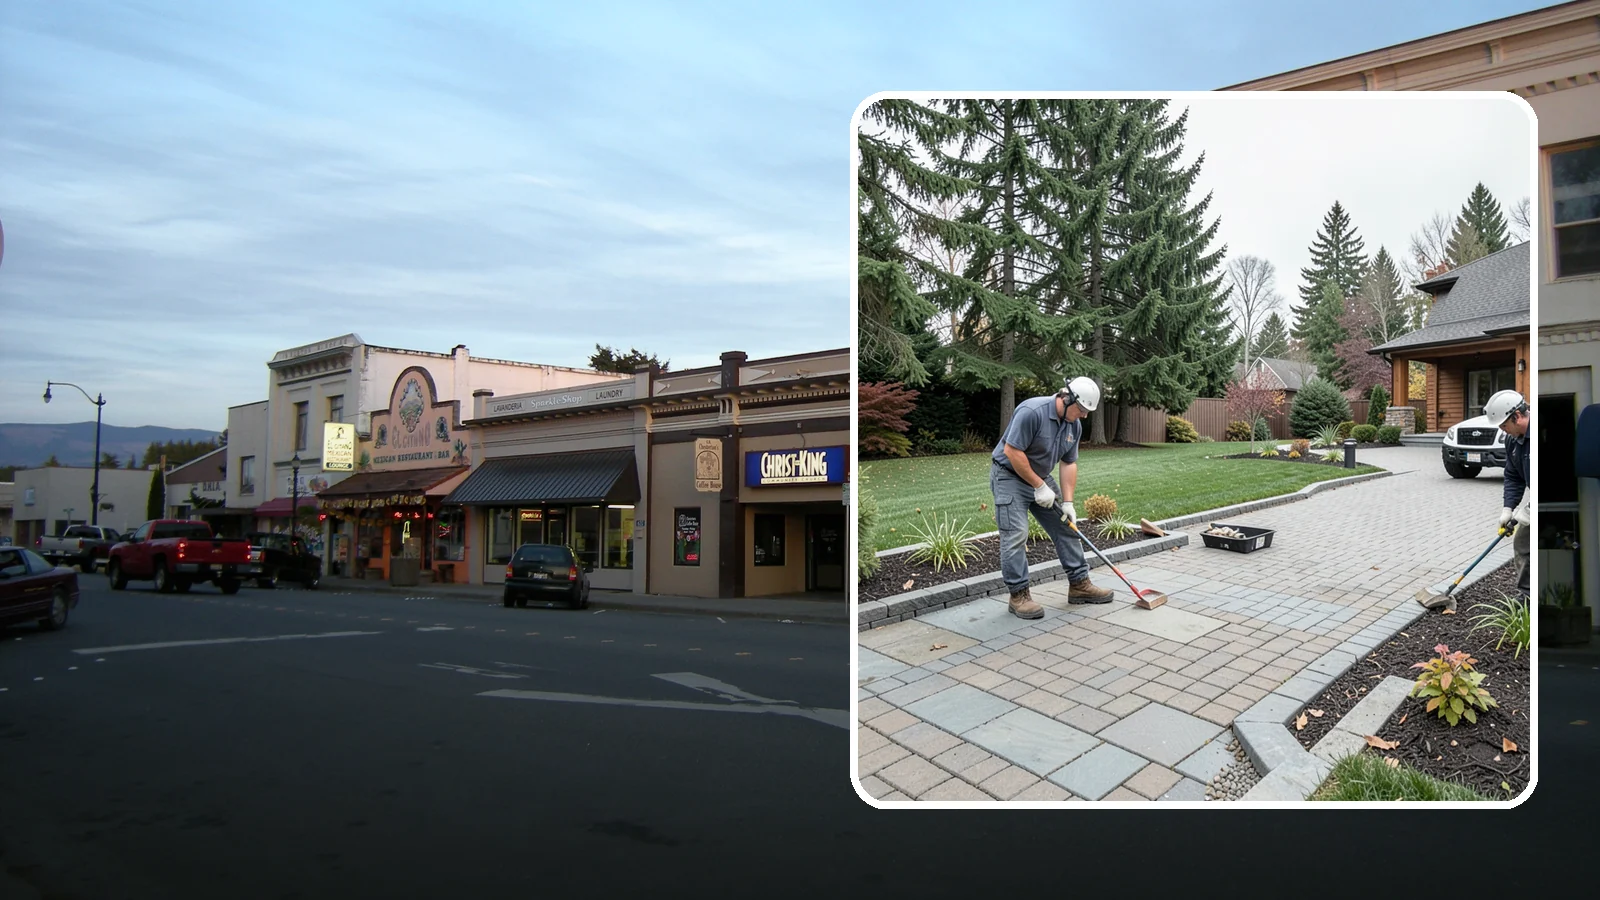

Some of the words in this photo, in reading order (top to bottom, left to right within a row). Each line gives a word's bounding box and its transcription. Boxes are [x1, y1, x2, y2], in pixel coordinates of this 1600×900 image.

[595, 388, 624, 400] LAUNDRY
[493, 402, 523, 413] LAVANDERIA
[531, 397, 562, 408] Sparkle
[561, 394, 583, 405] Shop
[374, 455, 397, 464] MEXICAN
[397, 451, 434, 463] RESTAURANT
[437, 450, 450, 459] BAR
[760, 452, 797, 478] CHRIST
[799, 450, 827, 476] KING
[696, 480, 709, 488] Coffee
[710, 480, 722, 489] House
